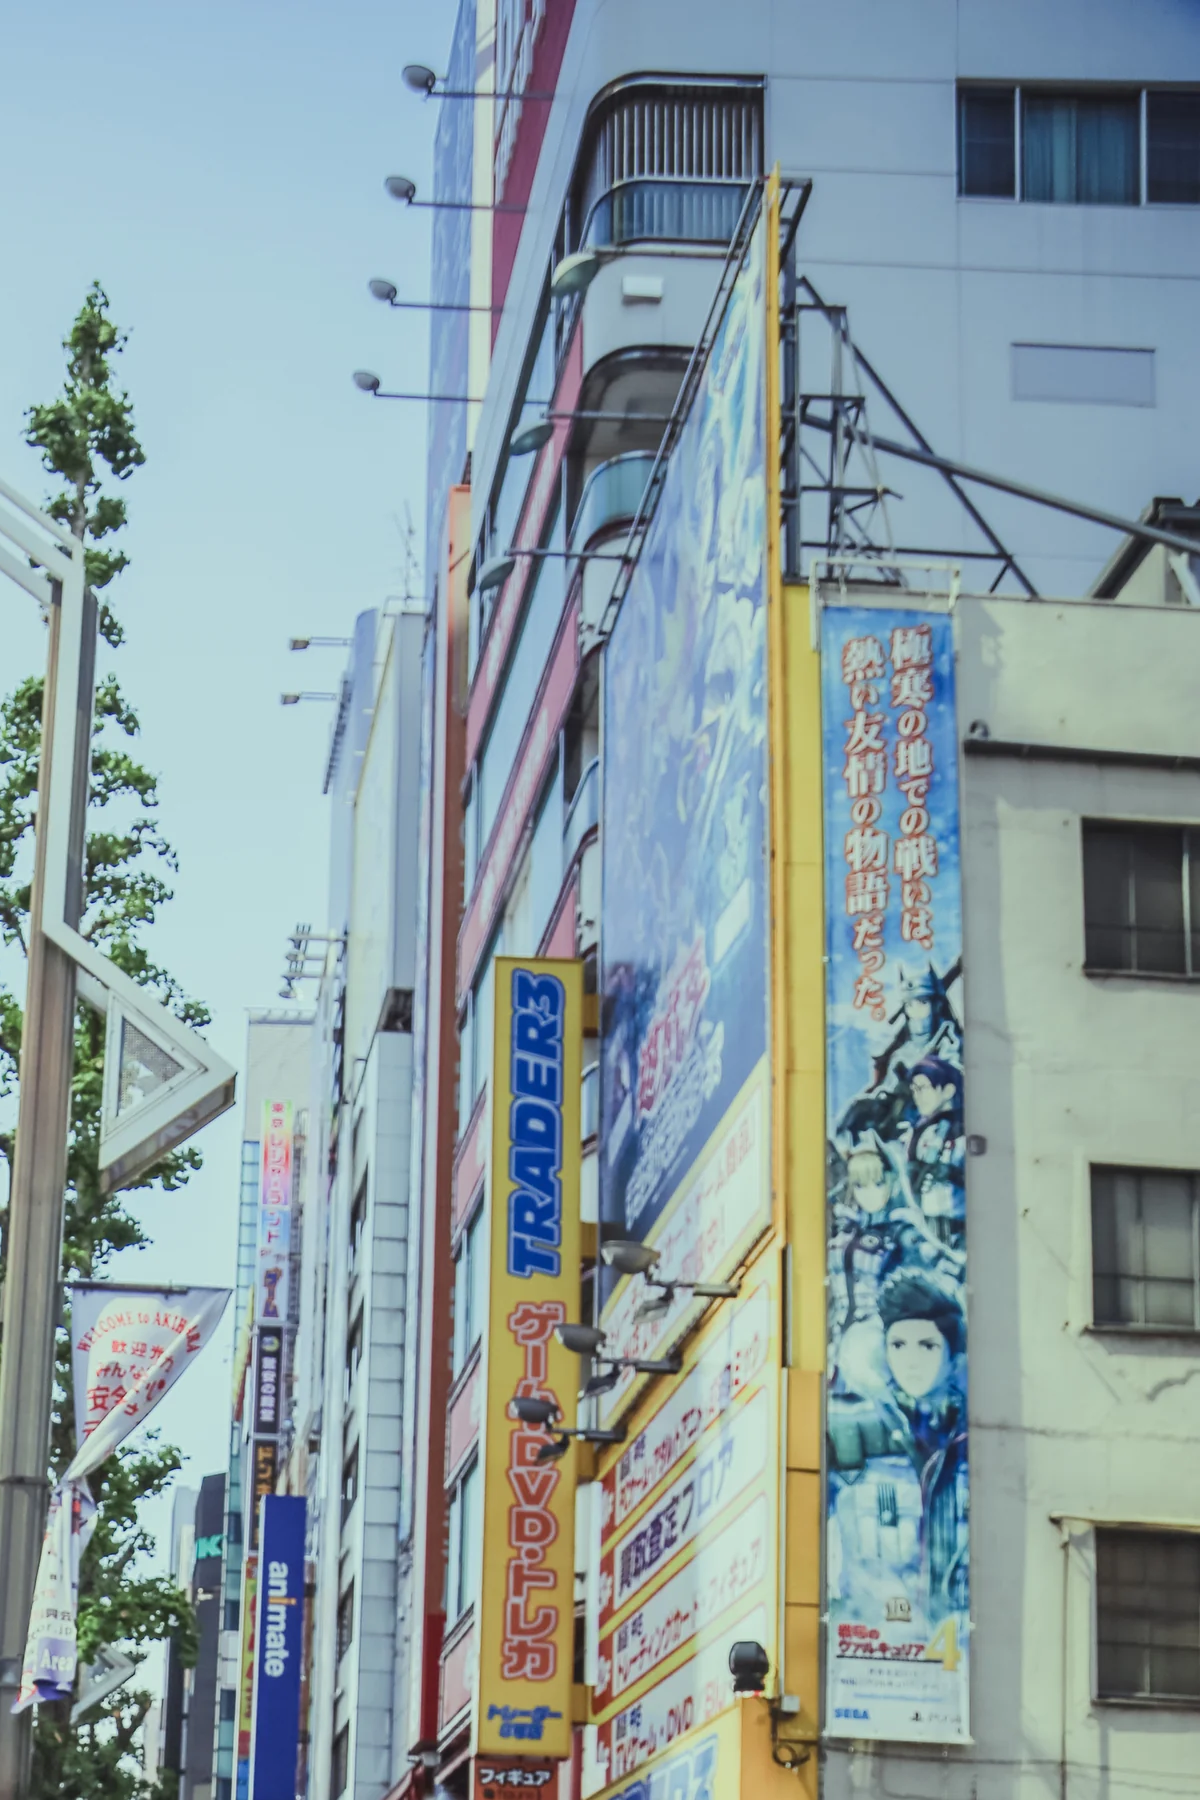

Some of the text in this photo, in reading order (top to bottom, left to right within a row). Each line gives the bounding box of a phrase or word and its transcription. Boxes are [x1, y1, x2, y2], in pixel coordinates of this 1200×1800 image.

[889, 622, 938, 951] 極寒の地での戦いは、
[842, 636, 890, 1022] 熱い友情の物語だった。
[509, 967, 567, 1280] TRADER3
[77, 1313, 134, 1352] WELCOME
[137, 1313, 150, 1324] to
[264, 1561, 297, 1678] animate
[39, 1649, 74, 1671] Area
[834, 1708, 869, 1720] SEGA
[480, 1768, 551, 1786] フィギュア
